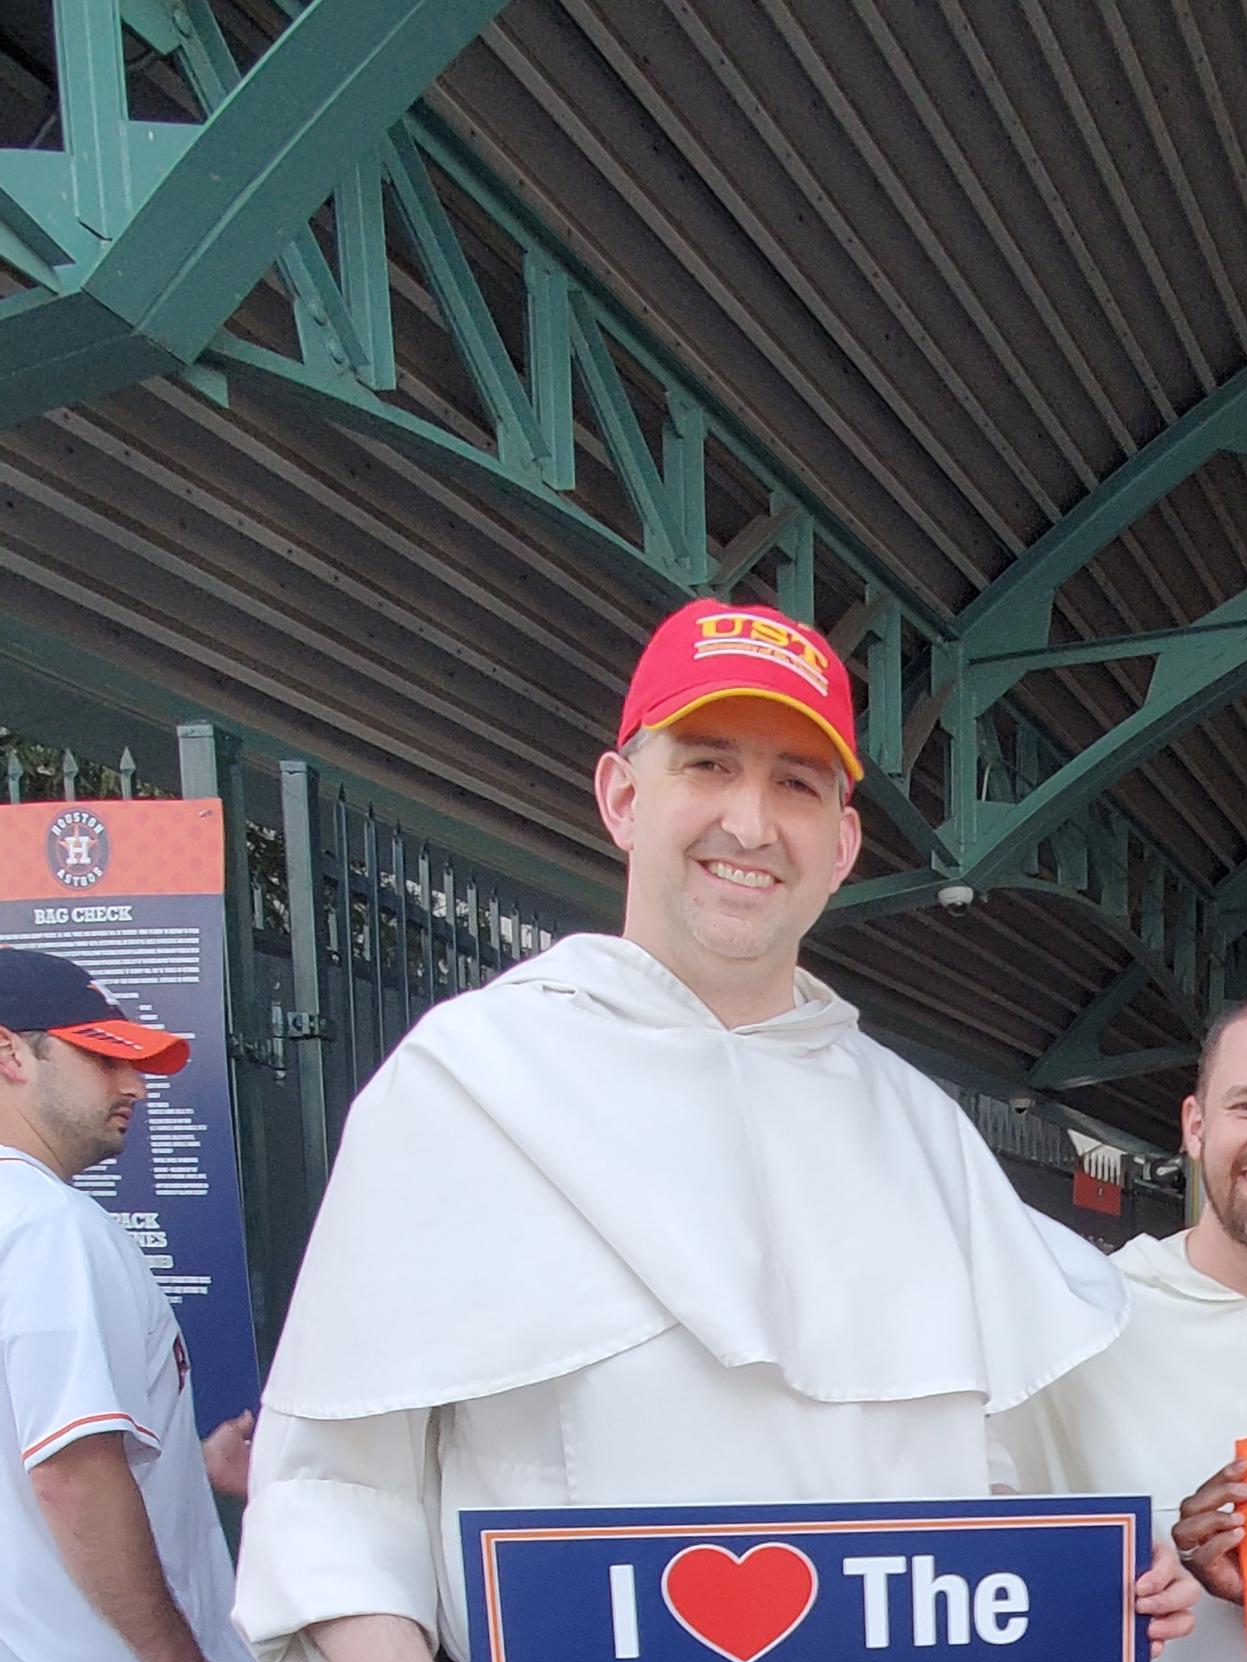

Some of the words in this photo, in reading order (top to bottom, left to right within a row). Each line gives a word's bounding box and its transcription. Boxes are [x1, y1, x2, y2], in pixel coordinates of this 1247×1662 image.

[701, 616, 829, 672] UST
[51, 811, 105, 836] HOUSTON
[64, 836, 92, 864] H
[56, 866, 103, 887] ASTROS
[34, 908, 69, 924] BAG
[71, 906, 133, 922] CHECK
[609, 1564, 640, 1659] I
[842, 1554, 1030, 1649] The
